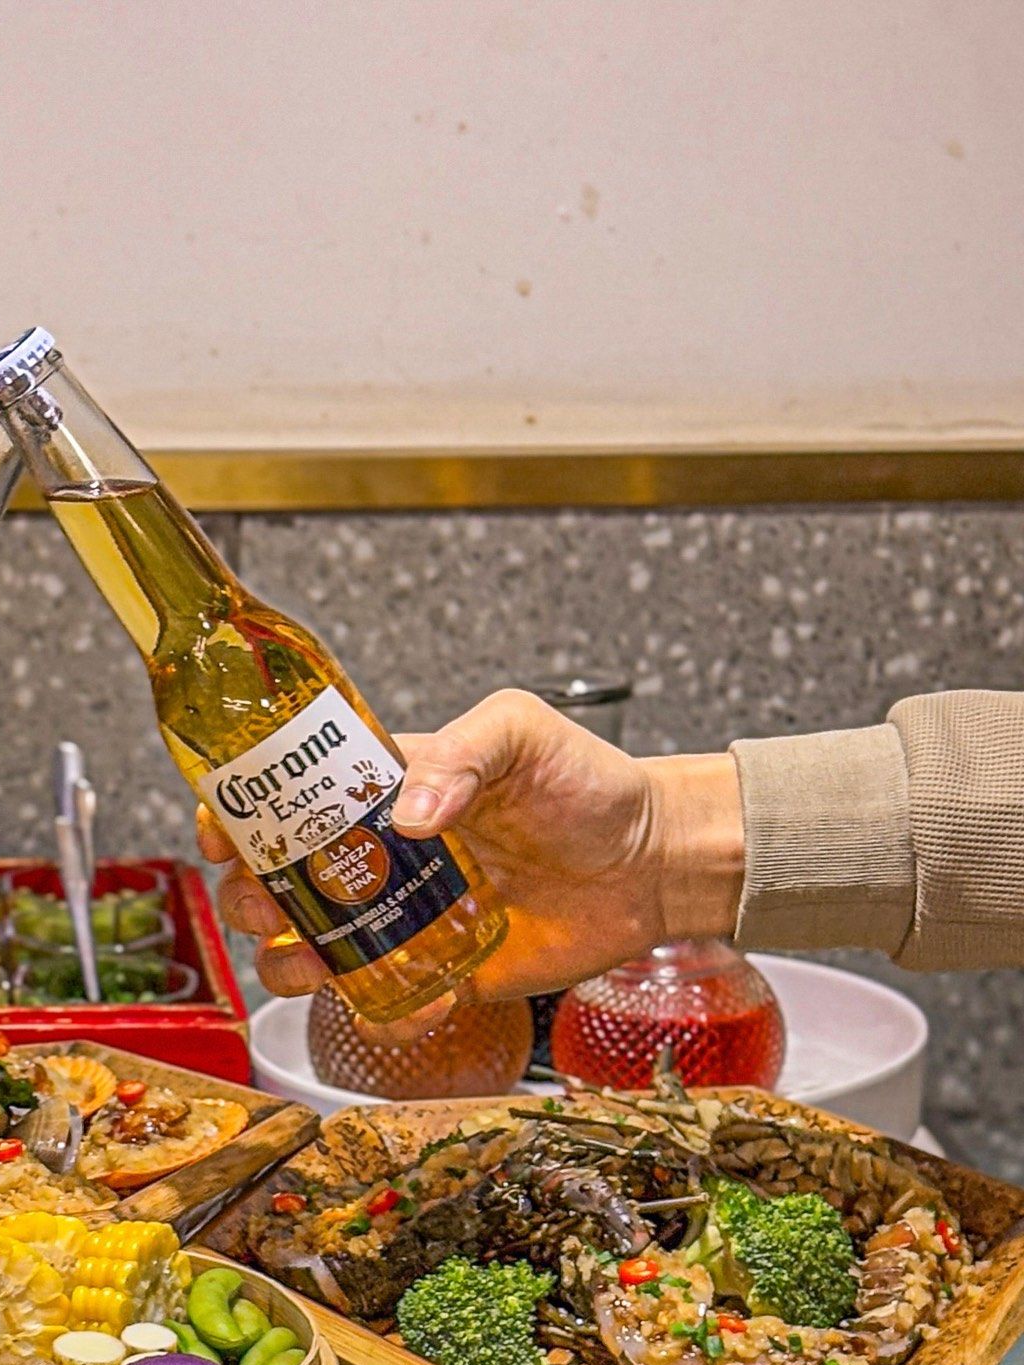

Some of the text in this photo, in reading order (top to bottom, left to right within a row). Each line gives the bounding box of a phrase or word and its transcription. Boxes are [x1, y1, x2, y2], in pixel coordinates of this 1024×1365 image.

[216, 720, 347, 819] Corona
[268, 776, 337, 822] Extra
[319, 841, 375, 881] CERVEZA
[329, 845, 350, 860] LA
[340, 861, 368, 884] MAS
[345, 871, 377, 895] FINA
